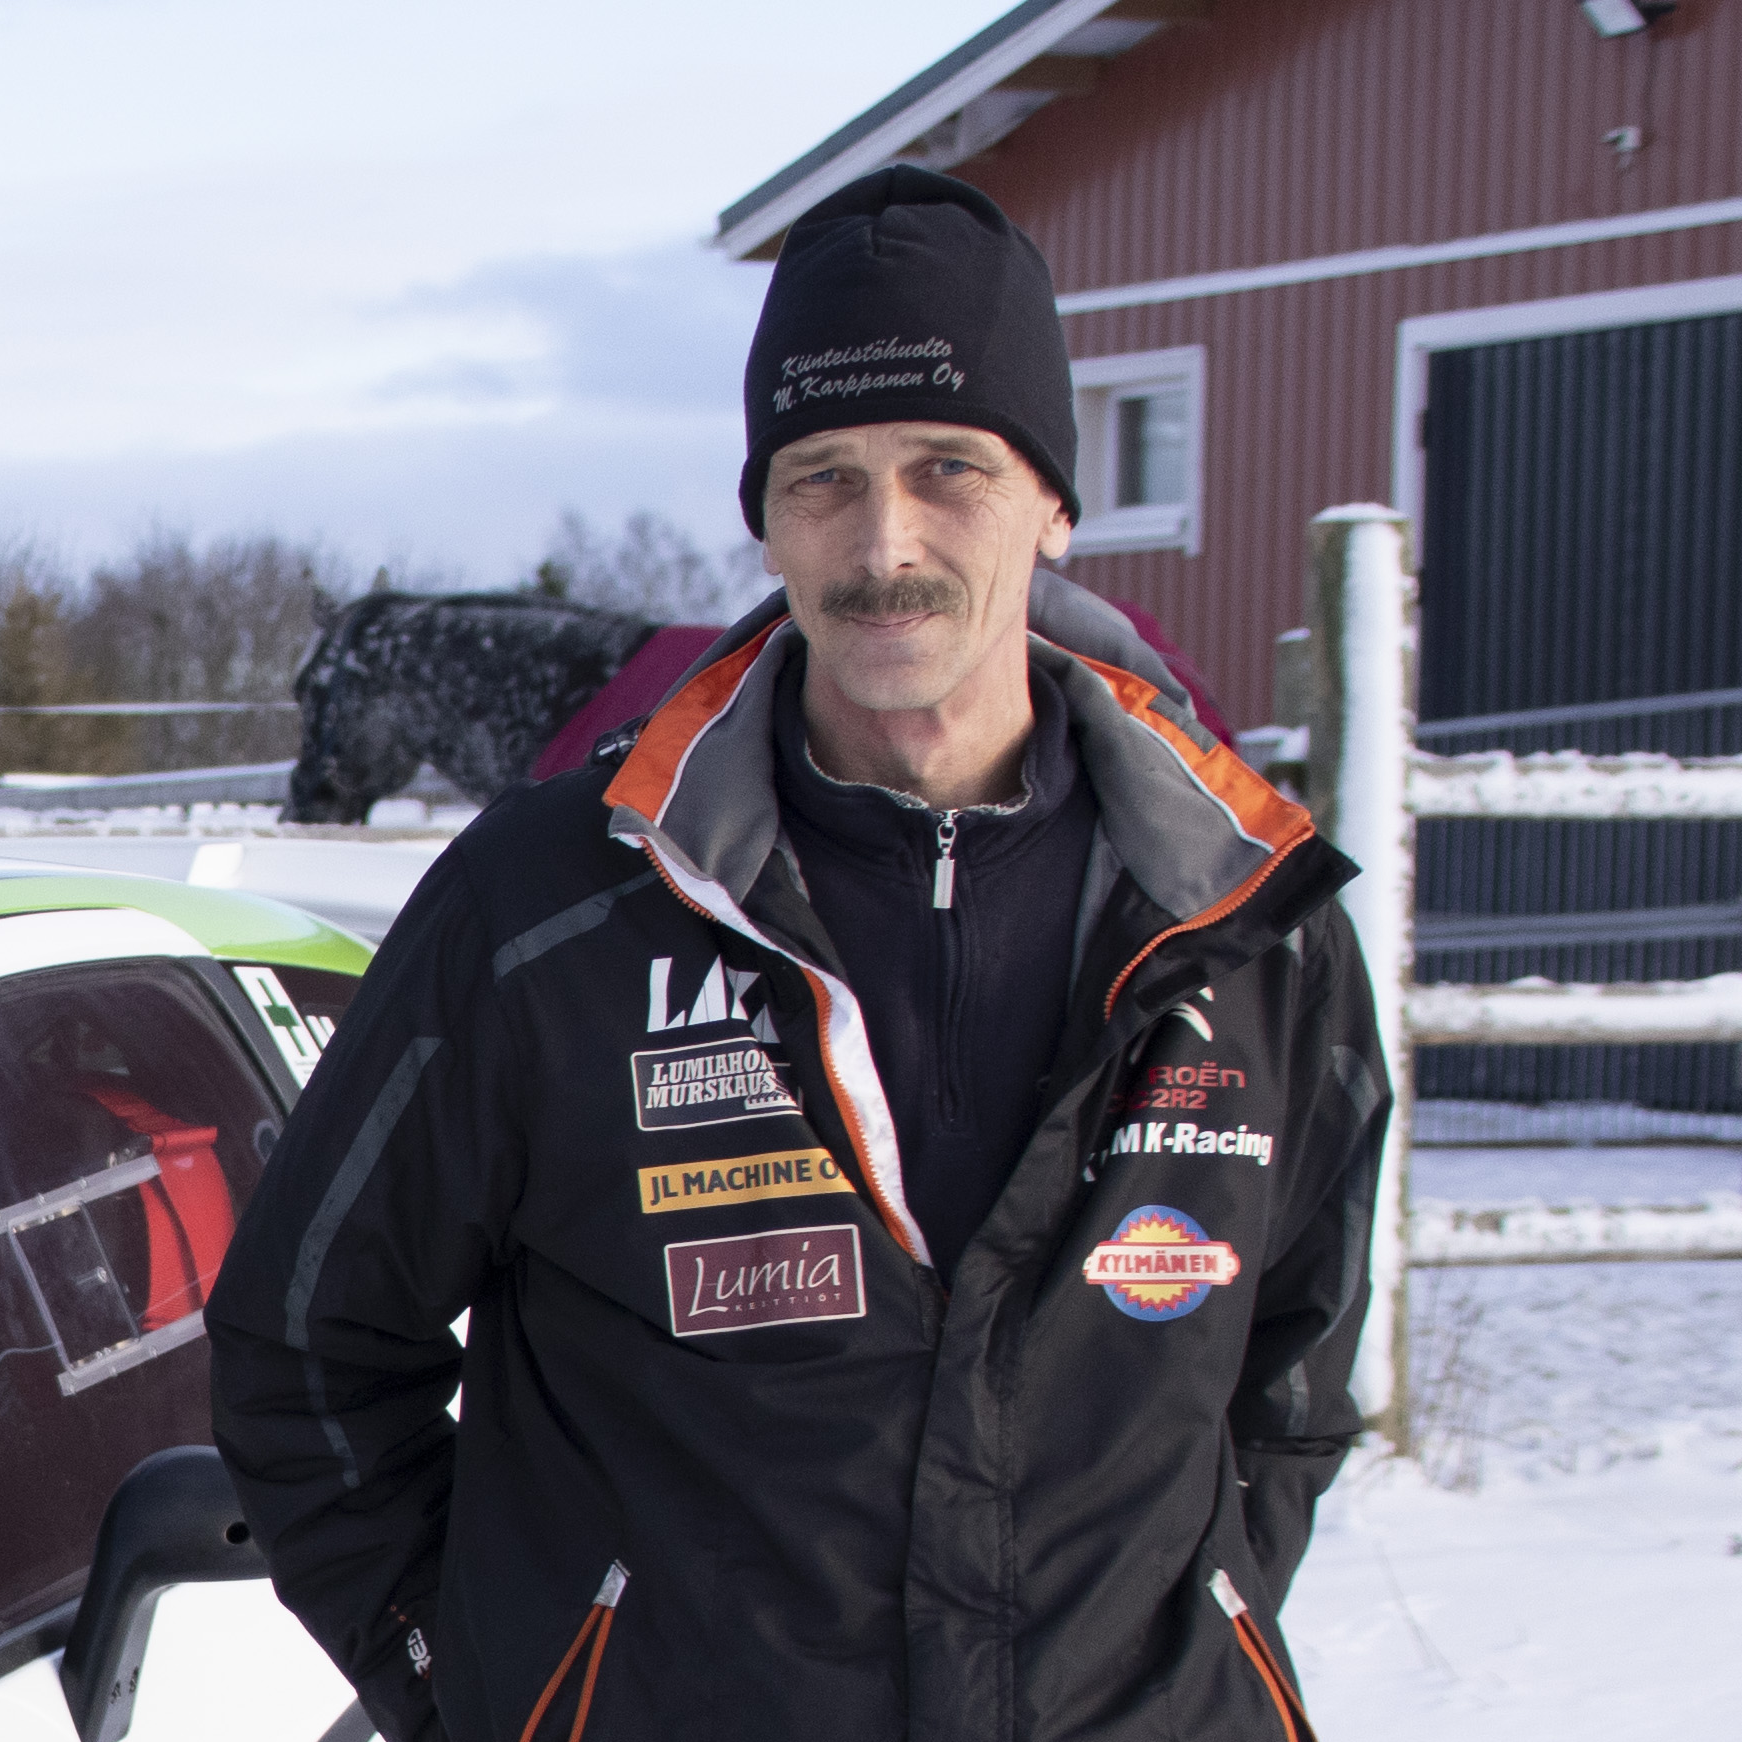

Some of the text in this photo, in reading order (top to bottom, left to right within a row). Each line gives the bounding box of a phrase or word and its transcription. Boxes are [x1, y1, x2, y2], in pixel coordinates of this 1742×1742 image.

[781, 335, 953, 381] Kiinteistöhuolto
[800, 371, 925, 400] Karppanen
[932, 361, 965, 391] Oy
[645, 1071, 777, 1109] MURSKAUS
[651, 1174, 678, 1206] JL
[683, 1158, 813, 1196] MACHINE
[688, 1241, 840, 1317] Lumia
[1097, 1250, 1218, 1274] KYLMÄNEN
